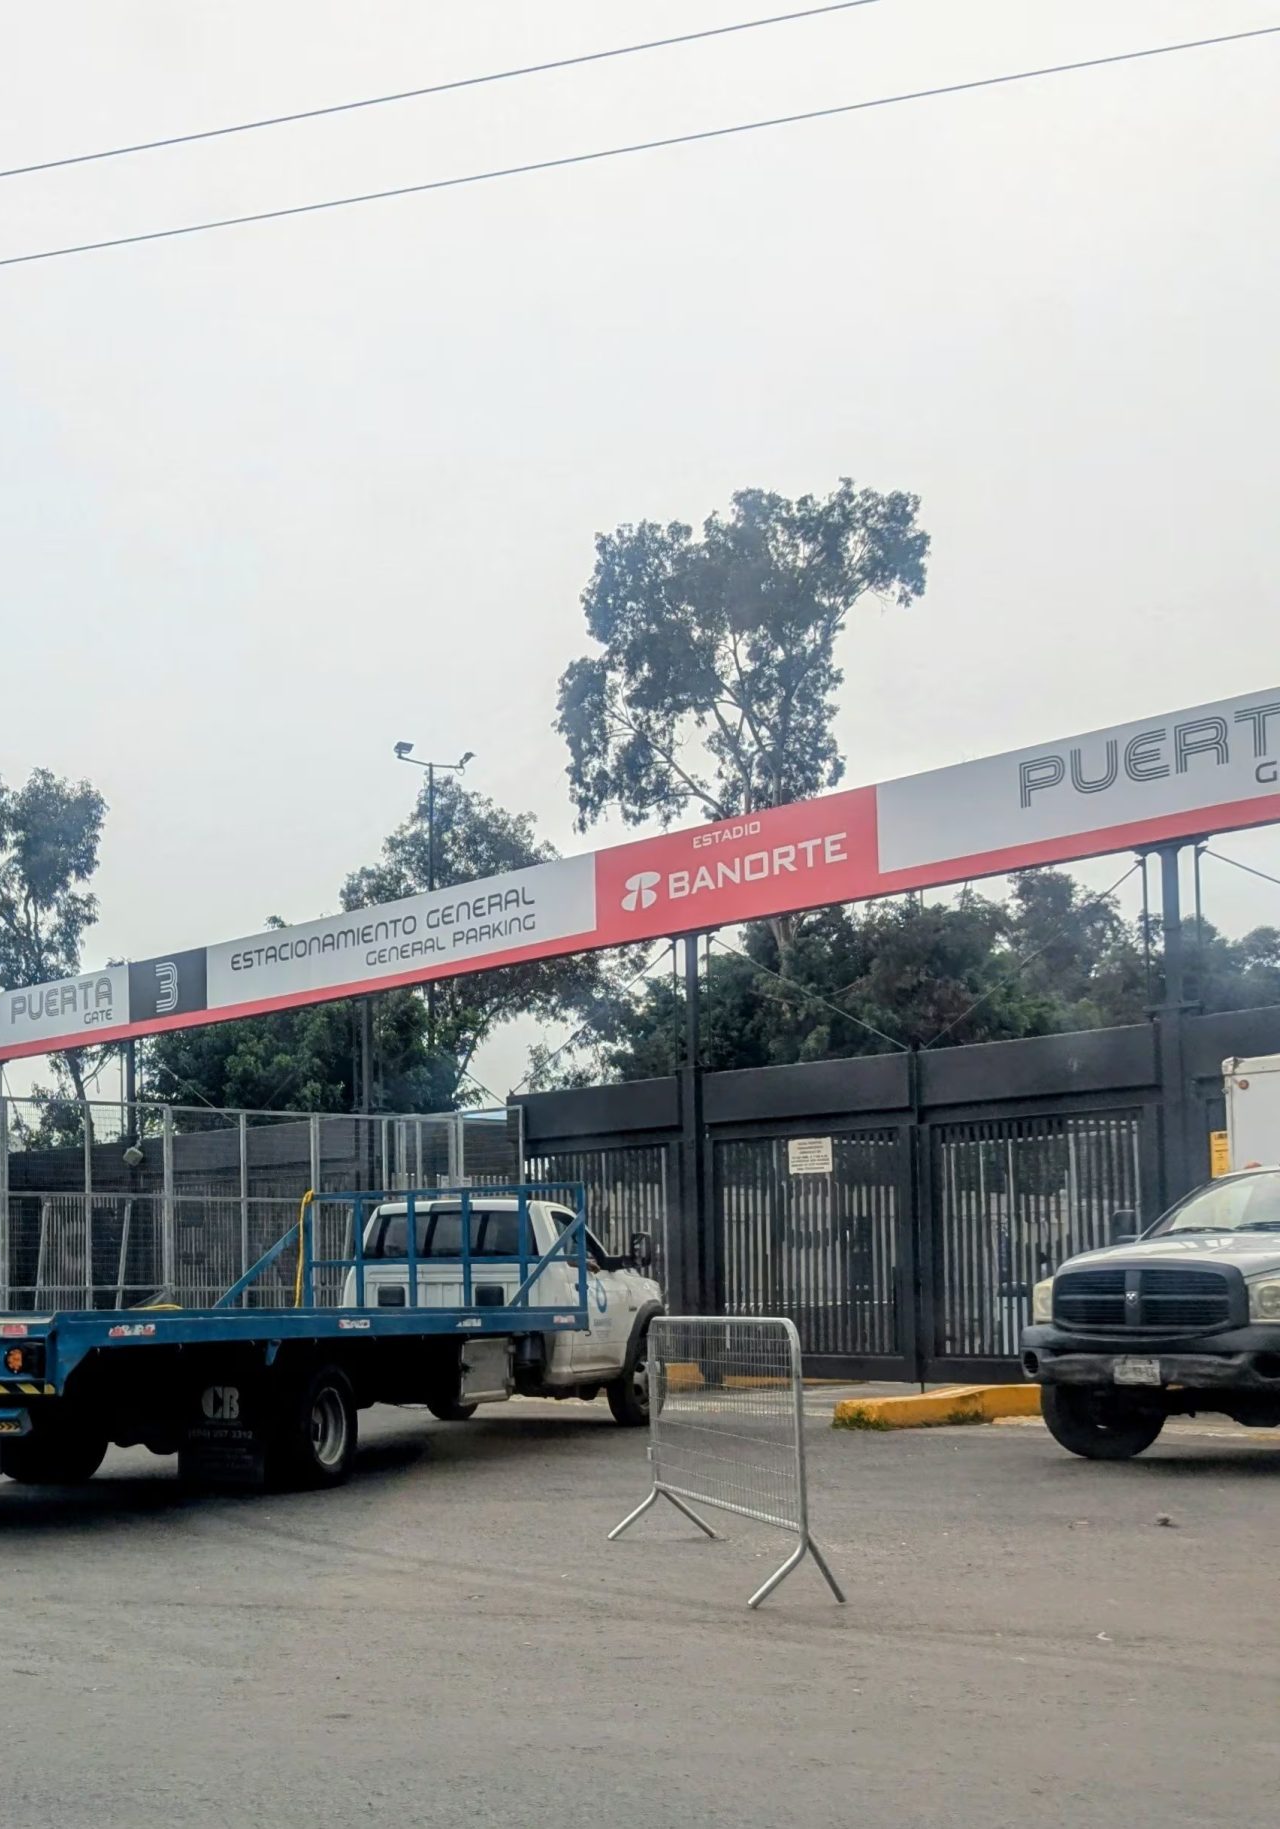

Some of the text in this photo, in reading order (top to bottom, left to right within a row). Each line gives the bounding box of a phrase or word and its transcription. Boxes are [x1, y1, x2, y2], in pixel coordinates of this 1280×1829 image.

[692, 820, 761, 849] ESTADIO
[668, 832, 848, 900] BANORTE
[230, 886, 536, 972] ESTACIONAMIENTO GENERAL
[365, 913, 536, 966] GENERAL PARKING
[10, 977, 113, 1025] PUERTA
[155, 961, 179, 1014] 3
[83, 1008, 113, 1025] GATE
